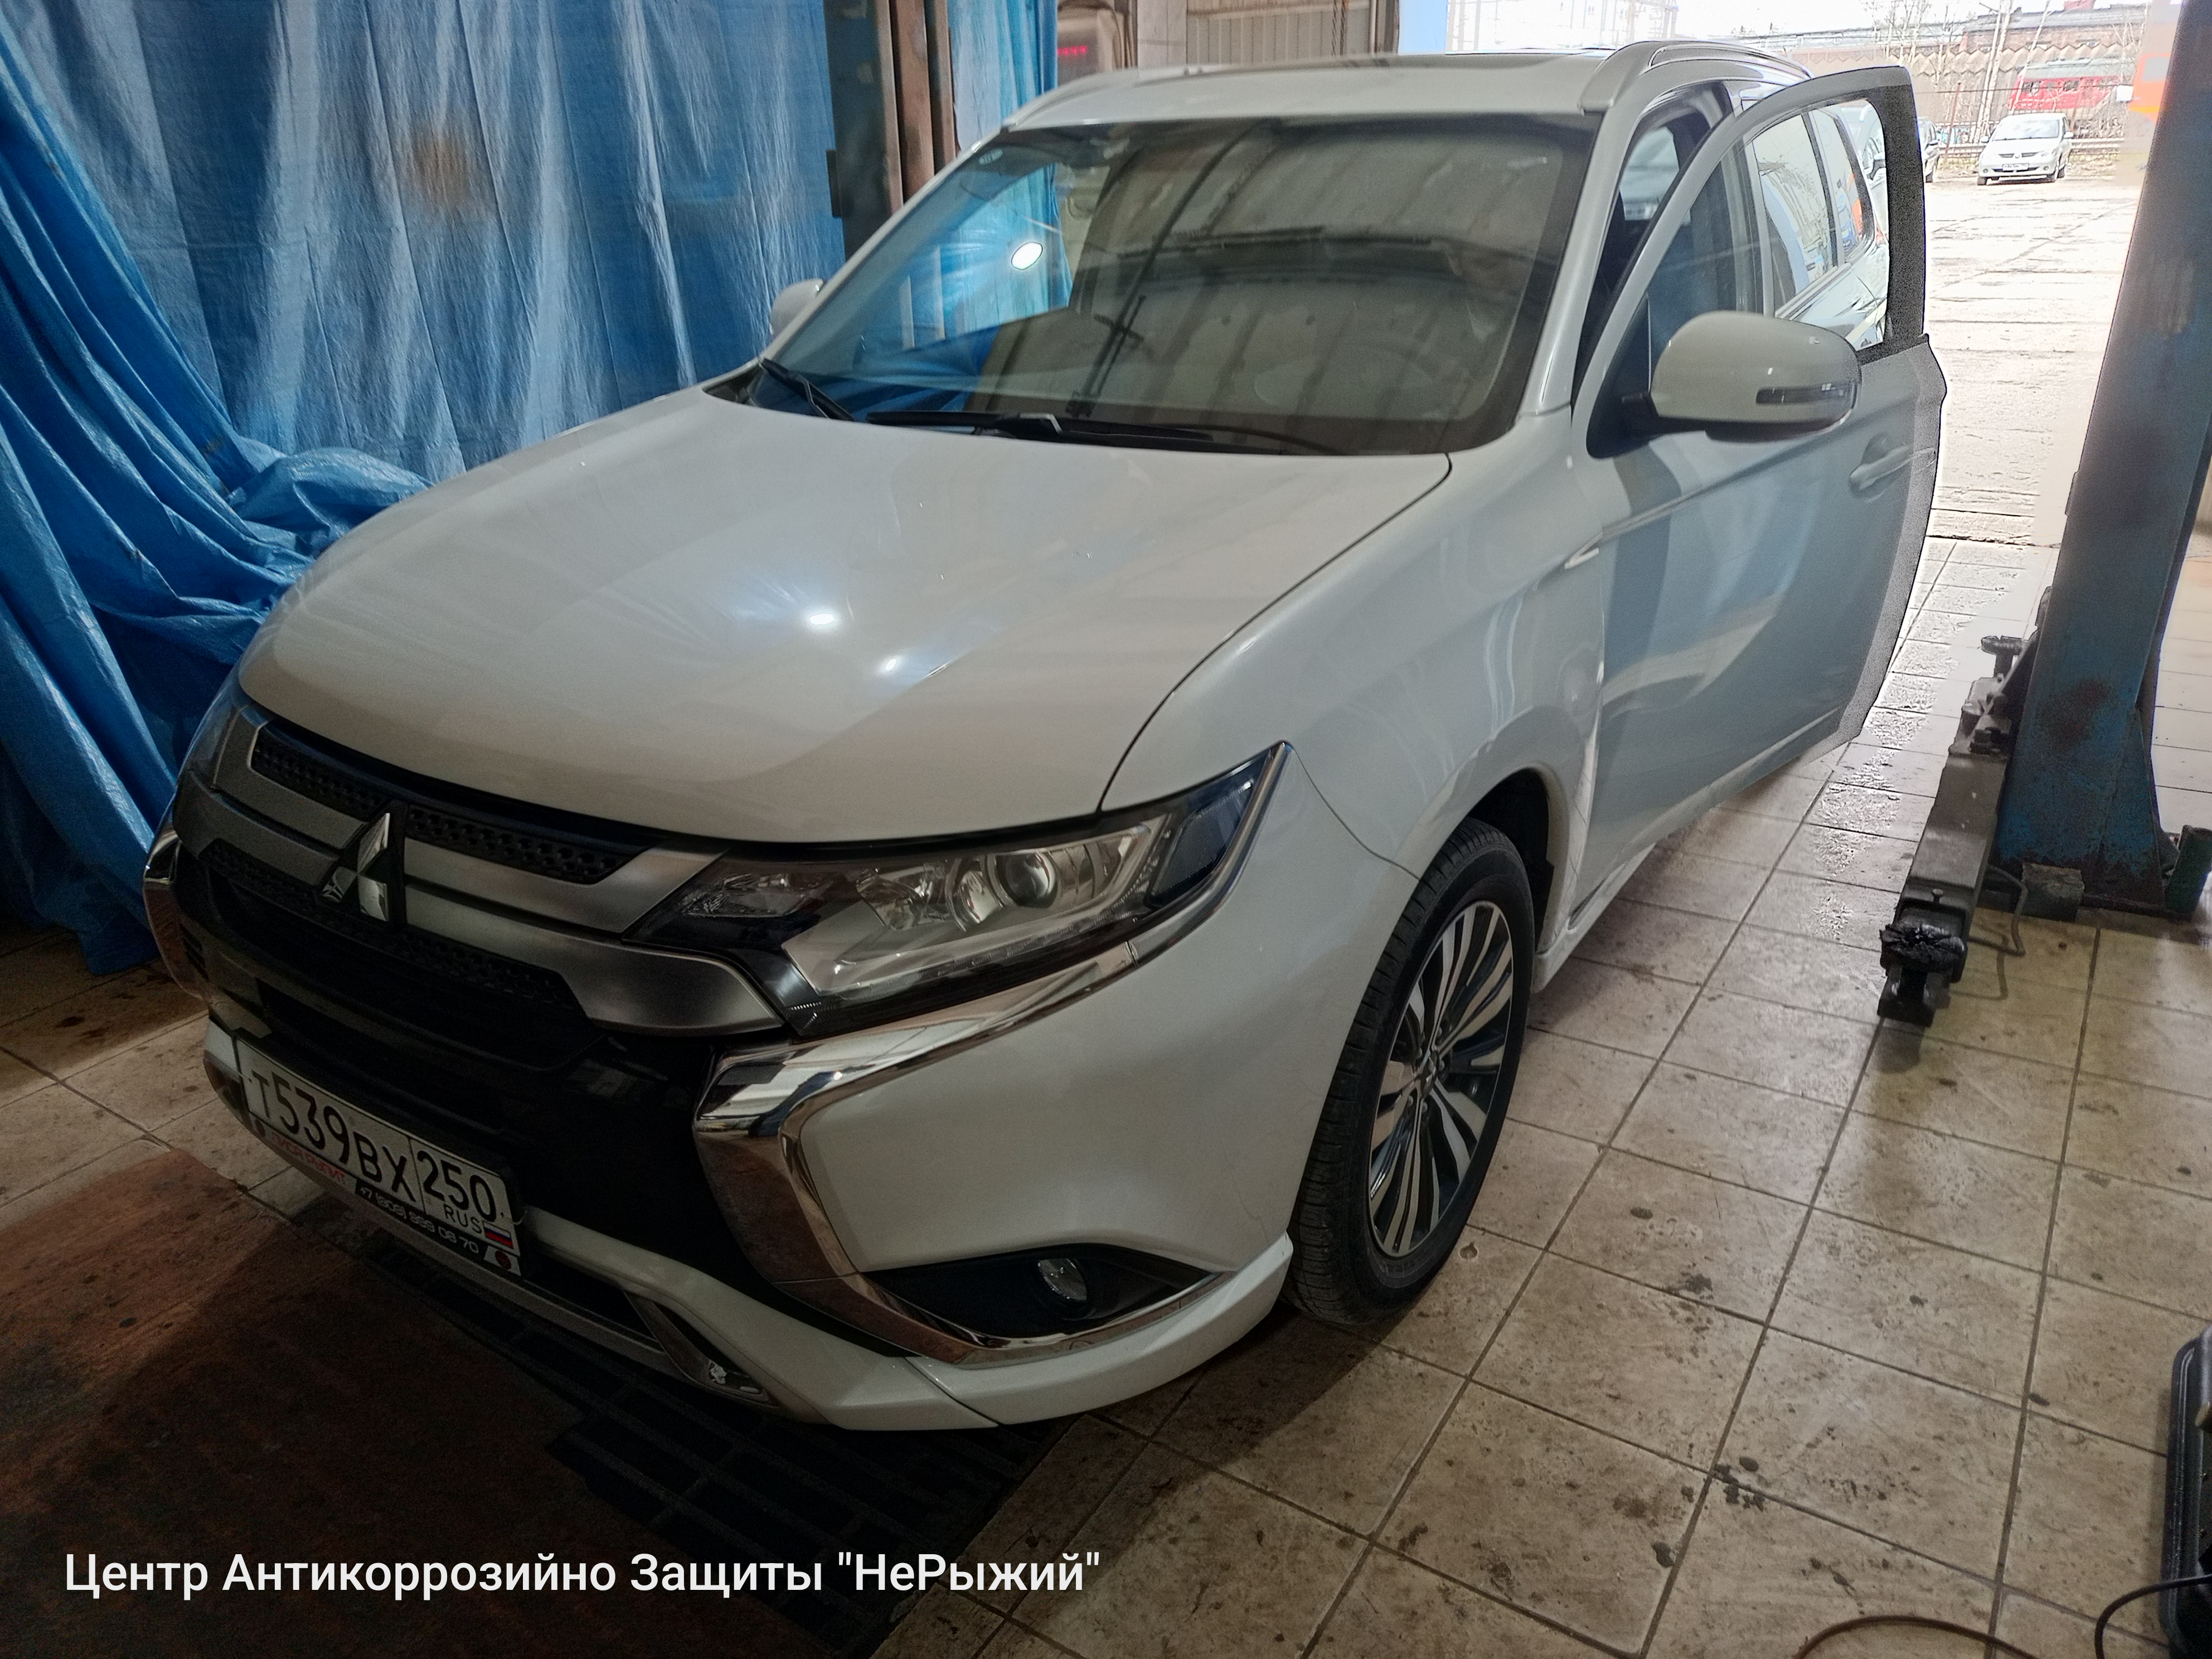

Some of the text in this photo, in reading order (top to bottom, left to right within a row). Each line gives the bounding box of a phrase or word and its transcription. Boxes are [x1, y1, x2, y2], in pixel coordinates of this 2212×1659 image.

[418, 1151, 497, 1223] 250
[444, 1204, 482, 1234] RUS
[459, 1236, 480, 1254] 70
